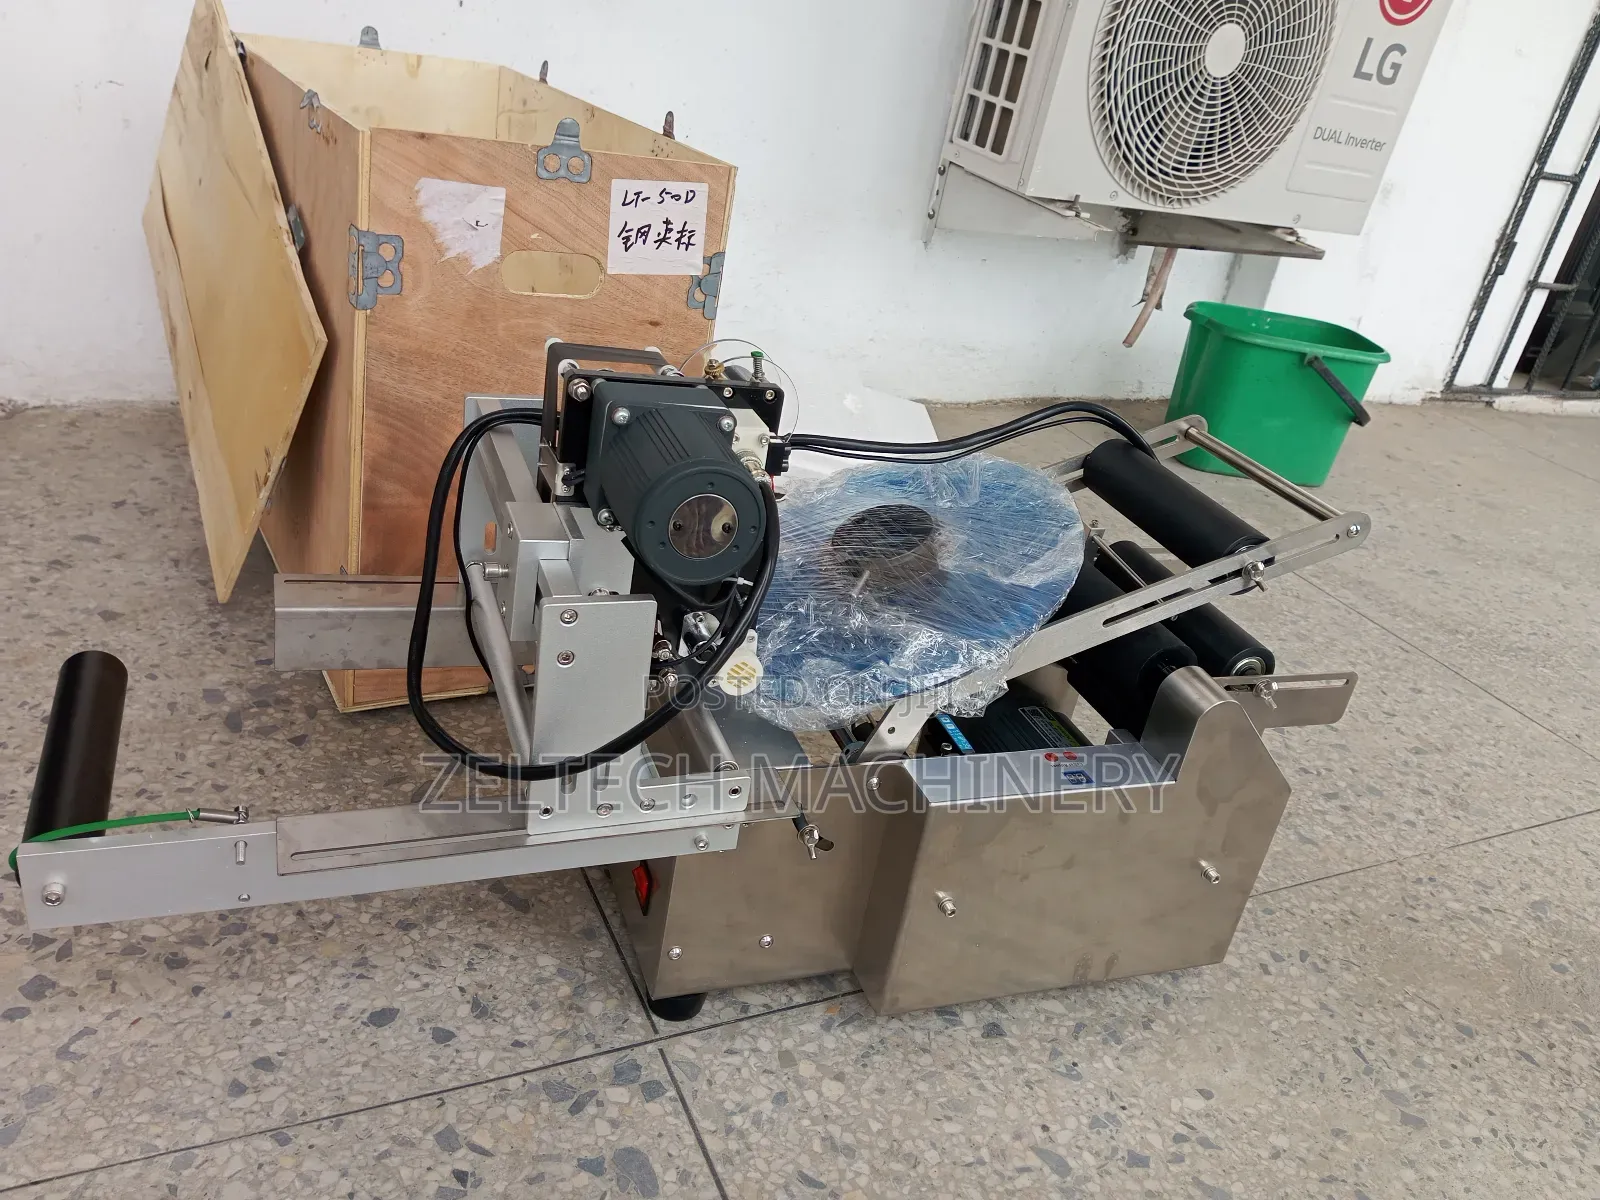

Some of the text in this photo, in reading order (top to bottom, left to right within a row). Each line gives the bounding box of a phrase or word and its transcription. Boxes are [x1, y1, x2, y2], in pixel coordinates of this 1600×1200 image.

[1352, 37, 1407, 86] LG
[1313, 126, 1387, 152] DUAL Inverter
